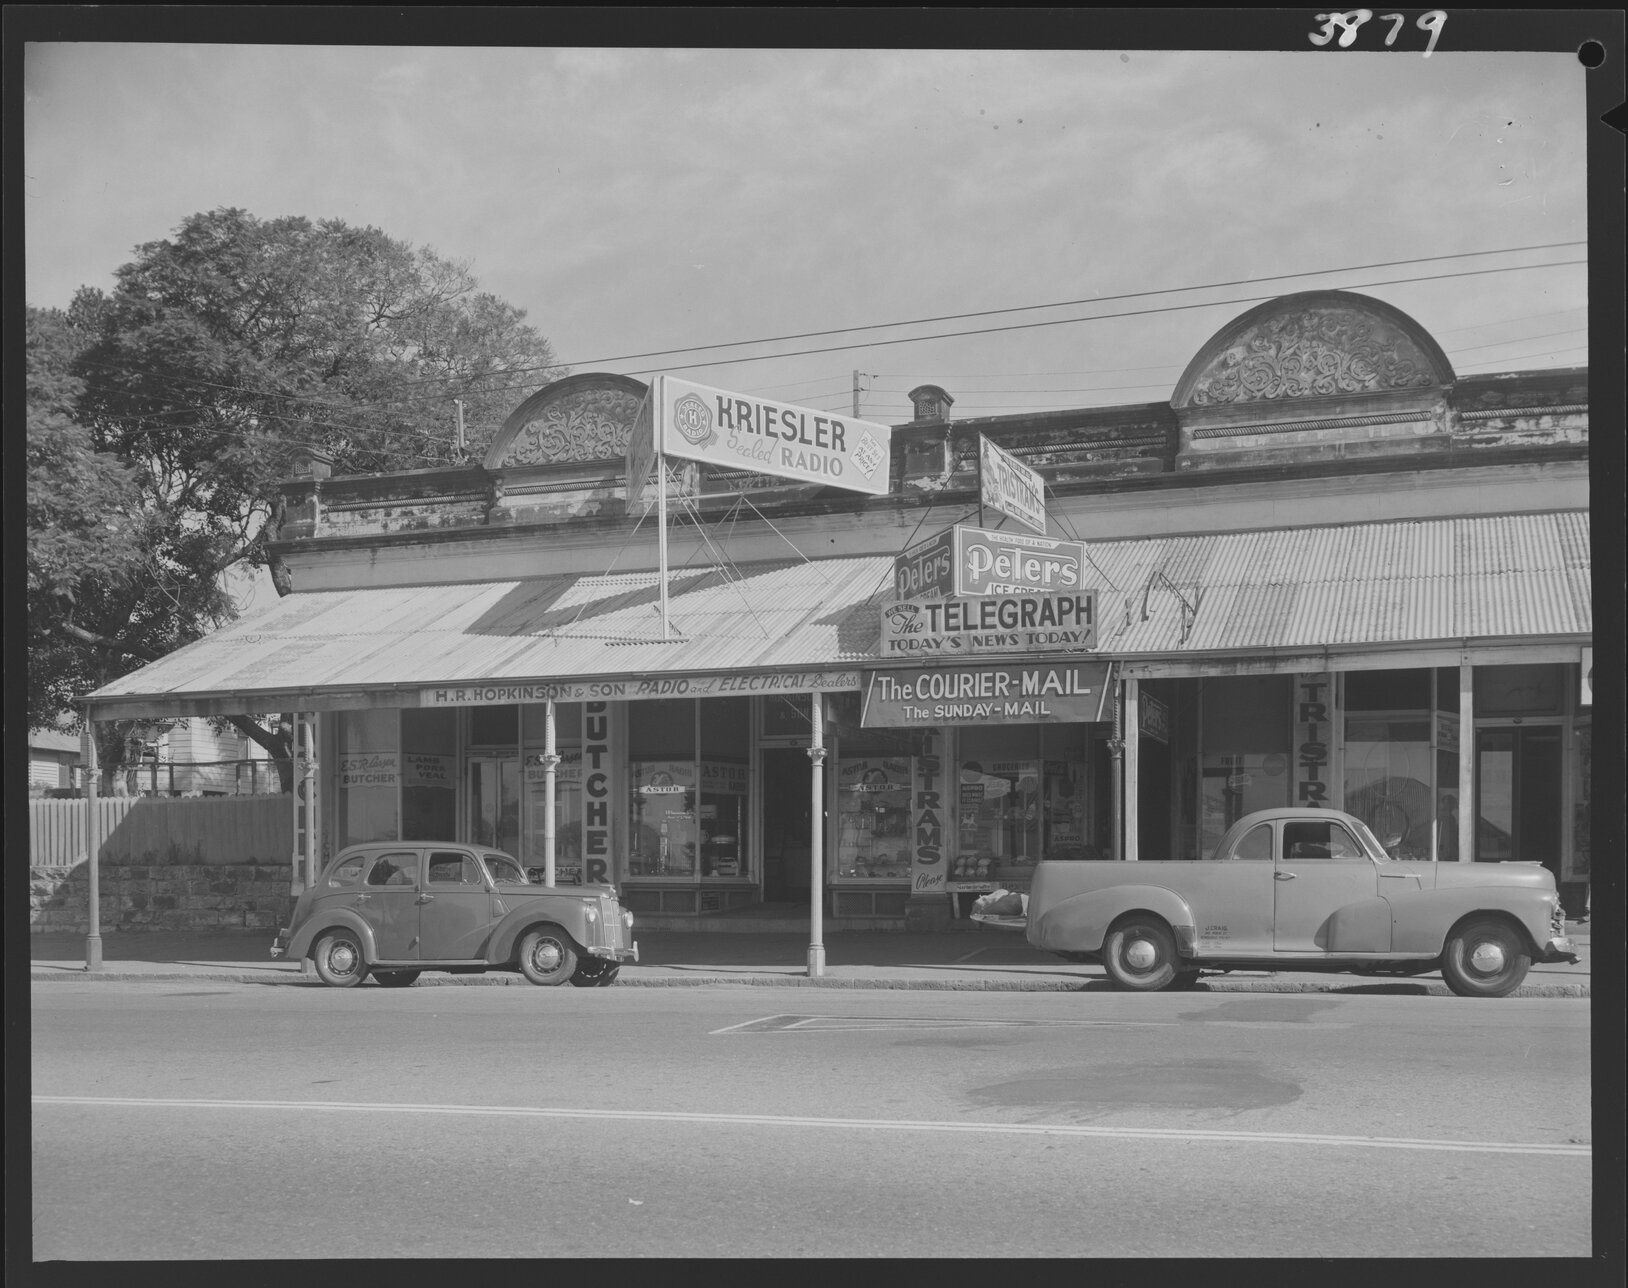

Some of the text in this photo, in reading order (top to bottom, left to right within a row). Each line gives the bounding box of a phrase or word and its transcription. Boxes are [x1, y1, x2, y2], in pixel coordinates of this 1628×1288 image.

[715, 395, 846, 452] KRIESLER
[726, 424, 843, 477] Sealed RADIO
[898, 545, 951, 603] Peters
[967, 544, 1079, 586] Peters
[991, 584, 1009, 595] ICE
[891, 595, 1093, 635] The TELEGRAPH
[898, 604, 917, 614] SELL
[888, 629, 1091, 651] TODAY'S NEWS TODAY!
[574, 688, 584, 698] &
[589, 684, 626, 698] SON
[635, 679, 690, 696] RADIO
[690, 678, 717, 694] and
[718, 674, 807, 692] ELECTRICAL
[809, 672, 857, 689] Dealers
[877, 669, 1091, 700] The COURIER-MAIL
[903, 700, 1051, 719] The SUNDAY-MAIL
[1299, 682, 1330, 808] TRISTR
[408, 755, 440, 764] LAMB
[702, 765, 746, 780] ASTOR
[343, 774, 396, 785] BUTCHER
[419, 771, 448, 780] VEAL
[916, 728, 942, 865] ISTRAMS
